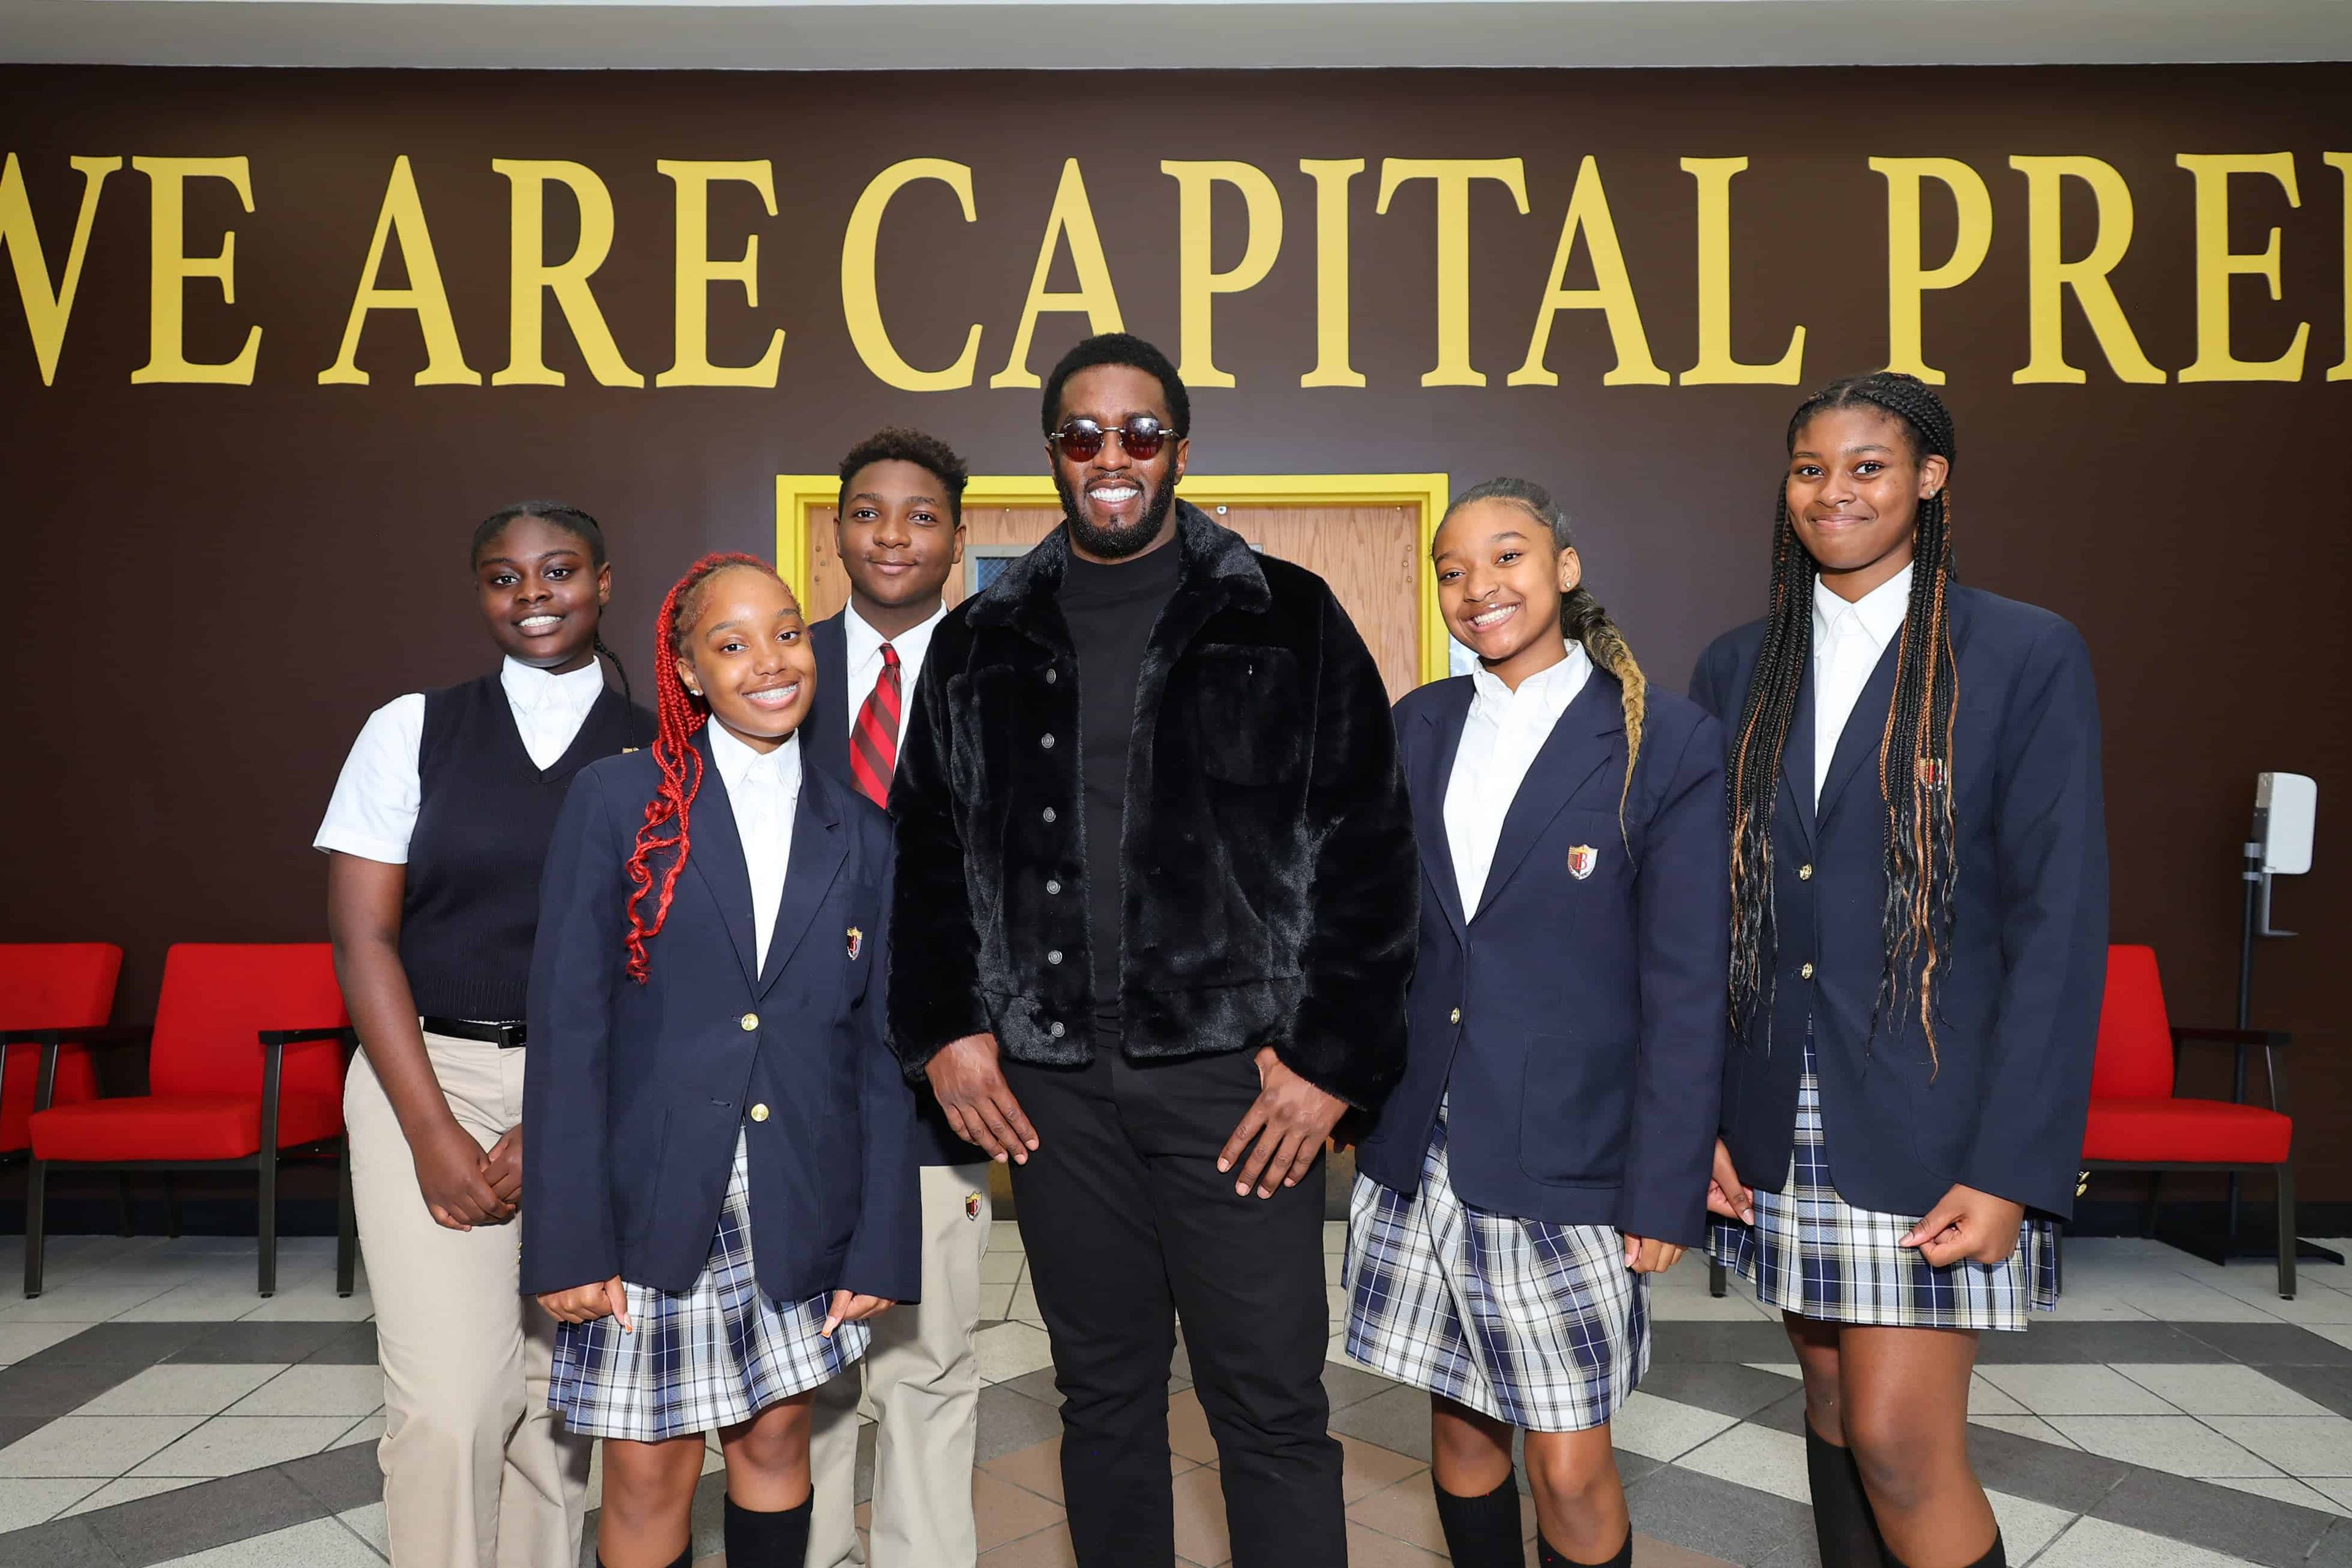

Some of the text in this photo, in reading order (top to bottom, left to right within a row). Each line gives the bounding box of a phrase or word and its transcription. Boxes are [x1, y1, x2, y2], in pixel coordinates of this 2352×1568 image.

[318, 155, 786, 388] ARE
[841, 155, 1806, 392] CAPITAL
[1868, 151, 2352, 386] PRE
[1575, 852, 1588, 870] B
